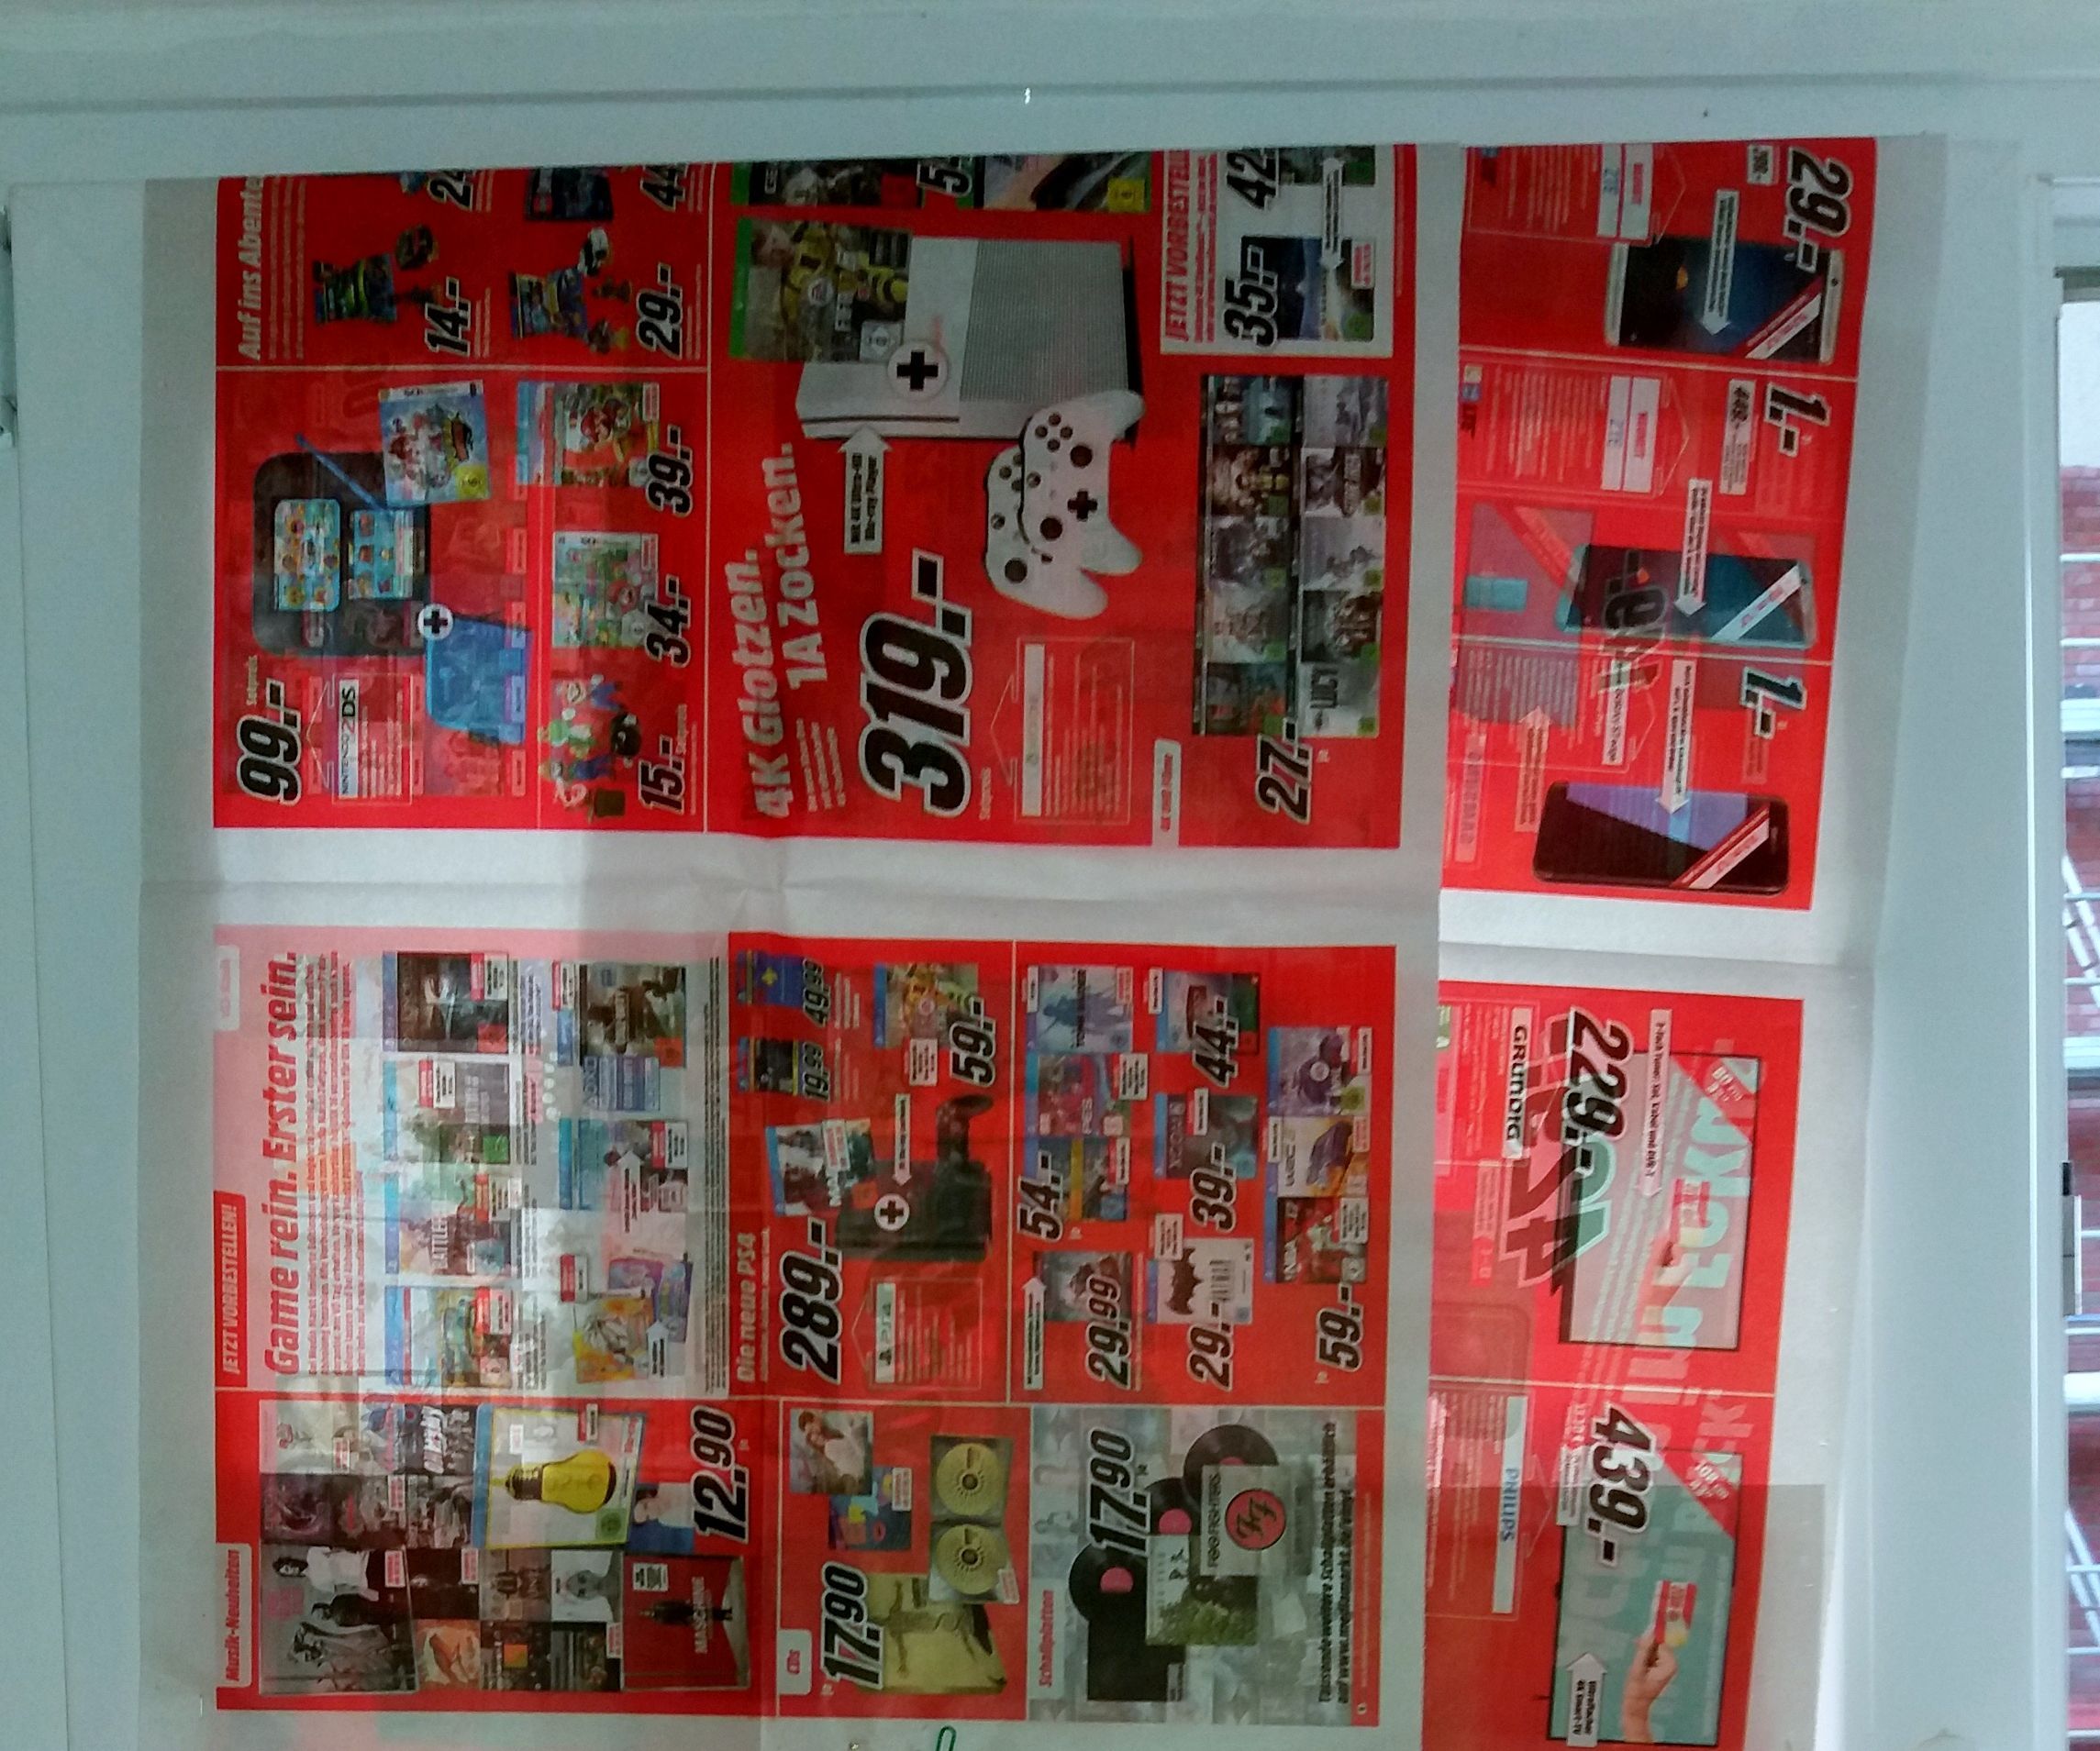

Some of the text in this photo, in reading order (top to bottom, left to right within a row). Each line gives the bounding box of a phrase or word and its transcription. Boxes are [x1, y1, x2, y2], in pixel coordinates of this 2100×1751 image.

[1783, 146, 1854, 273] 29.-
[238, 311, 261, 360] Auf
[239, 270, 261, 309] ins
[425, 276, 472, 357] 14.-
[635, 262, 683, 360] 29.-
[1165, 280, 1188, 342] JETZT
[1224, 244, 1278, 347] 35.-
[1763, 382, 1831, 457] 1.-
[644, 424, 694, 517] 39.-
[761, 442, 828, 690] 1A Zocken.
[642, 574, 692, 668] 34.-
[724, 549, 794, 817] 4K Glotzen.
[858, 548, 973, 817] 319.-
[1739, 666, 1806, 740] 1.-
[236, 678, 302, 804] 99.-
[339, 686, 357, 794] NINTENDO 2DS
[638, 735, 686, 815] 15.-
[1256, 718, 1312, 824] 27.-
[802, 957, 831, 1026] 49.99
[948, 992, 997, 1086] 59.-
[802, 1041, 831, 1103] 19.99
[1193, 996, 1239, 1088] 44.-
[1506, 1025, 1528, 1141] GRUNDIG
[1562, 1007, 1633, 1176] 229.-
[261, 950, 299, 1376] Game rein. Erster sein.
[1017, 1150, 1063, 1241] 54.-
[1189, 1140, 1237, 1233] 39.-
[220, 1203, 239, 1374] JETZT VORBESTELLEN!
[737, 1232, 757, 1381] Die neue PS4
[779, 1214, 842, 1382] 289.-
[1084, 1273, 1132, 1391] 29.99
[1316, 1281, 1362, 1371] 59.-
[1187, 1301, 1235, 1391] 29.-
[690, 1404, 750, 1544] 12.90
[1087, 1428, 1152, 1557] 17.90
[1500, 1468, 1519, 1542] PHILIPS
[1584, 1403, 1657, 1569] 439.-
[225, 1549, 239, 1681] Musik-Neuheiten
[820, 1560, 884, 1689] 17.90
[1039, 1590, 1054, 1688] Schallplatten
